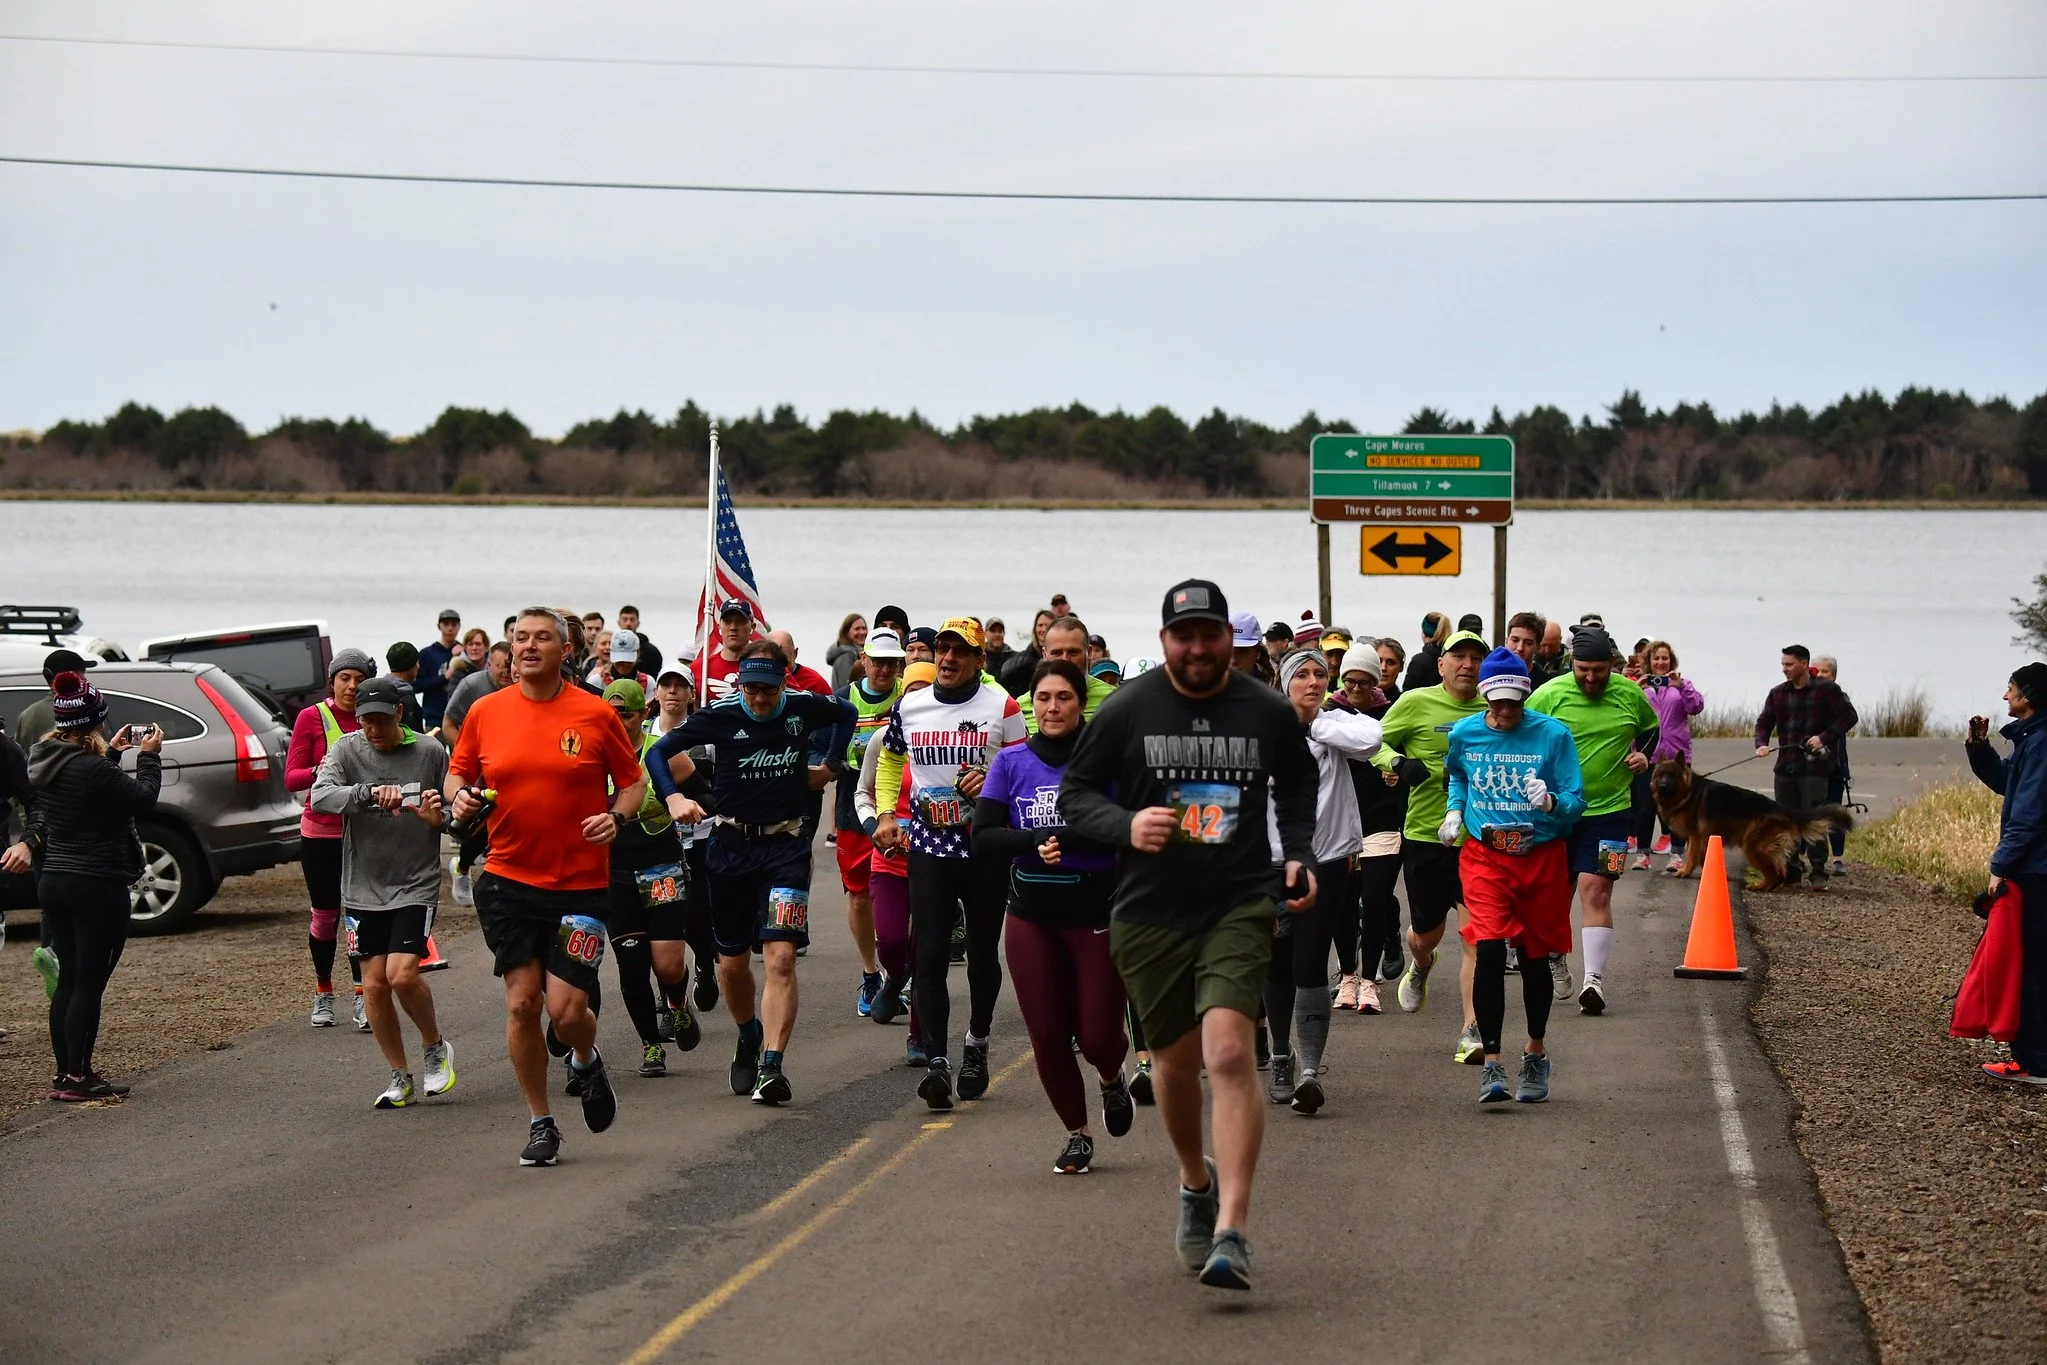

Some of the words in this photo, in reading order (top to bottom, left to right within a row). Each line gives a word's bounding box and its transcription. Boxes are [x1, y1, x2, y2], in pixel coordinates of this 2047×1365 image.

[1365, 440, 1388, 451] Cape
[1392, 440, 1425, 450] Meares
[1369, 457, 1380, 465] NO
[1385, 457, 1425, 465] SERVICES
[1430, 457, 1441, 465] NO
[1445, 457, 1477, 466] OUTLET
[1372, 480, 1418, 490] Tillamook
[1424, 480, 1431, 490] 7
[1344, 505, 1370, 515] Three
[1374, 505, 1401, 518] Capes
[1406, 505, 1437, 516] Scenic
[1440, 506, 1458, 516] Rte.
[911, 730, 988, 747] MARATHON
[738, 745, 800, 768] Alaska
[1143, 734, 1261, 768] MONTANA
[1484, 753, 1491, 762] &
[1493, 753, 1542, 764] FURIOUS??
[740, 768, 794, 780] AIRLINES
[929, 800, 961, 825] 111
[1487, 801, 1494, 811] &
[1494, 802, 1534, 811] DELIRIOU
[1180, 803, 1224, 839] 42
[1492, 830, 1522, 853] 32
[651, 876, 678, 901] 48
[775, 901, 806, 928] 119
[566, 929, 599, 961] 60
